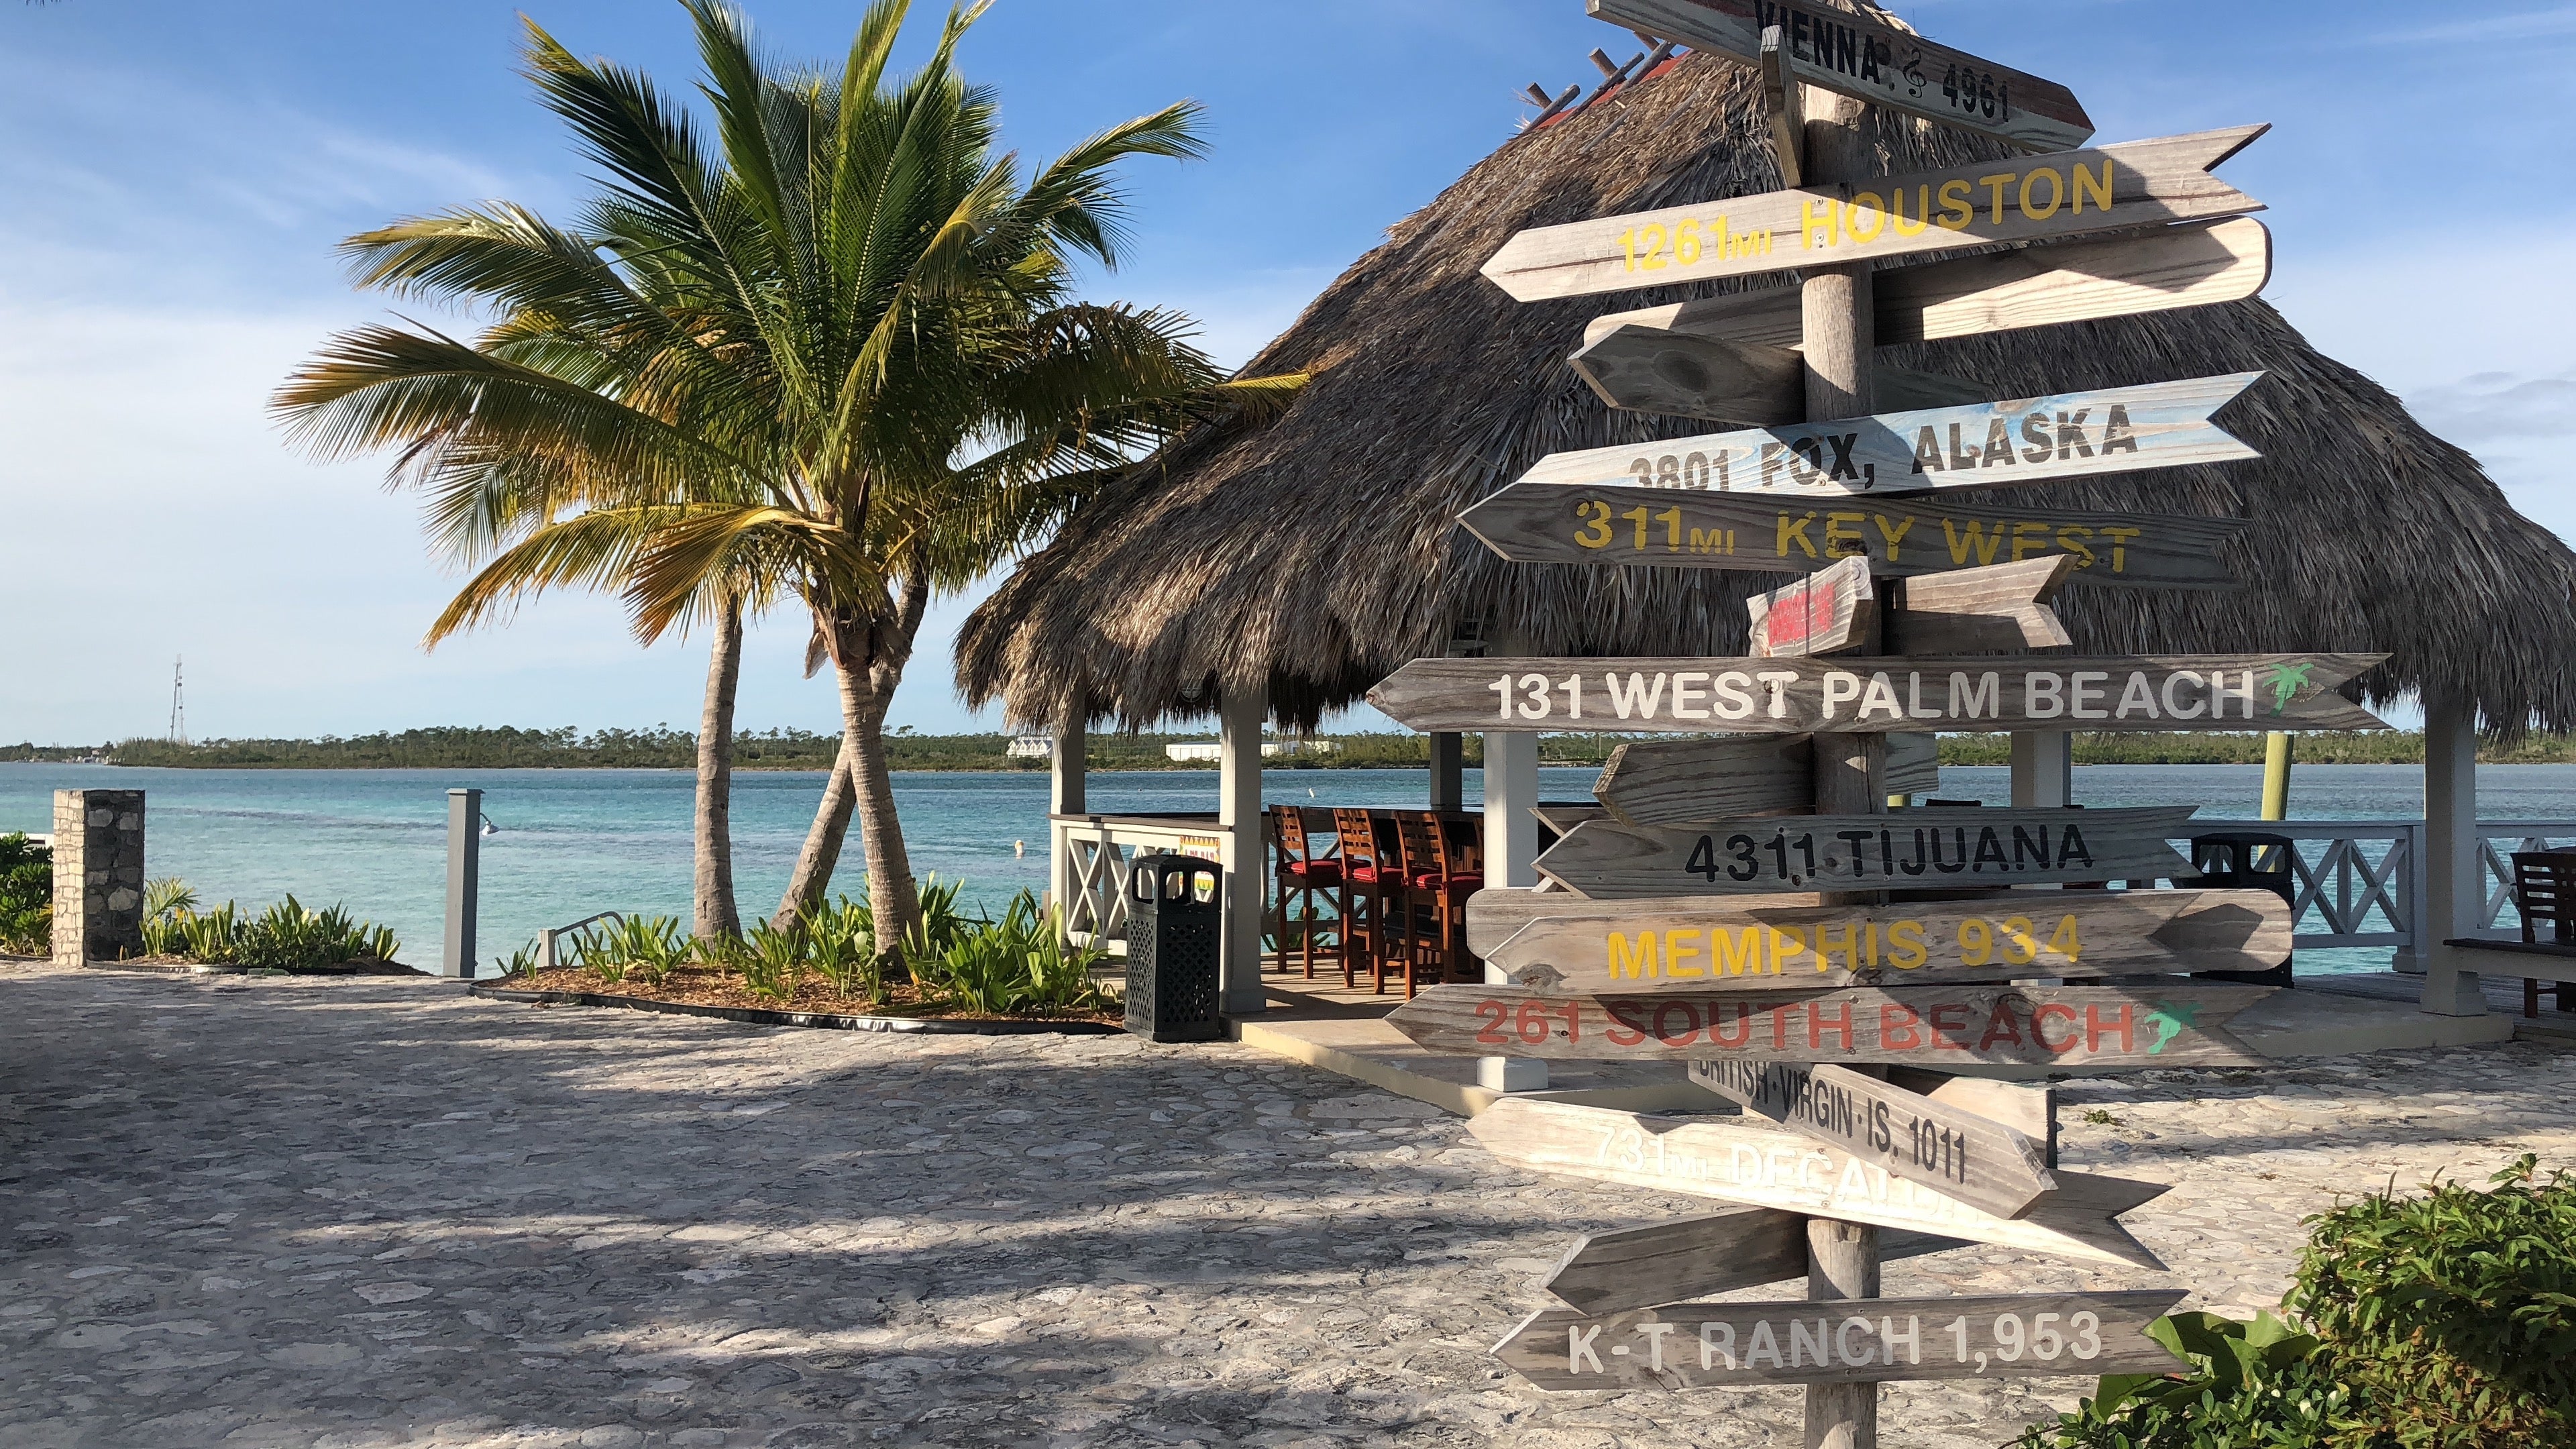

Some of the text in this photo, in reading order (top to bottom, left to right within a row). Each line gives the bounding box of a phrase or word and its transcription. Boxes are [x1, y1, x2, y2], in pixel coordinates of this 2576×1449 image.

[1943, 63, 2010, 123] 4961
[1802, 158, 2114, 250] HOUSTON
[1629, 404, 2138, 490] 3801 FOX, ALASKA
[1776, 510, 1915, 562] KEY
[1941, 517, 2141, 573] WEST
[1489, 671, 2253, 720] 131 WEST PALM BEACH
[1685, 824, 2094, 882] 4311 TIJUANA
[1609, 914, 2081, 979] MEMPHIS 934
[1476, 1000, 2134, 1053] 261 SOUTH BEACH
[1909, 1115, 1965, 1184] 1011
[1568, 1311, 2101, 1375] K-T RANCH 1,953
